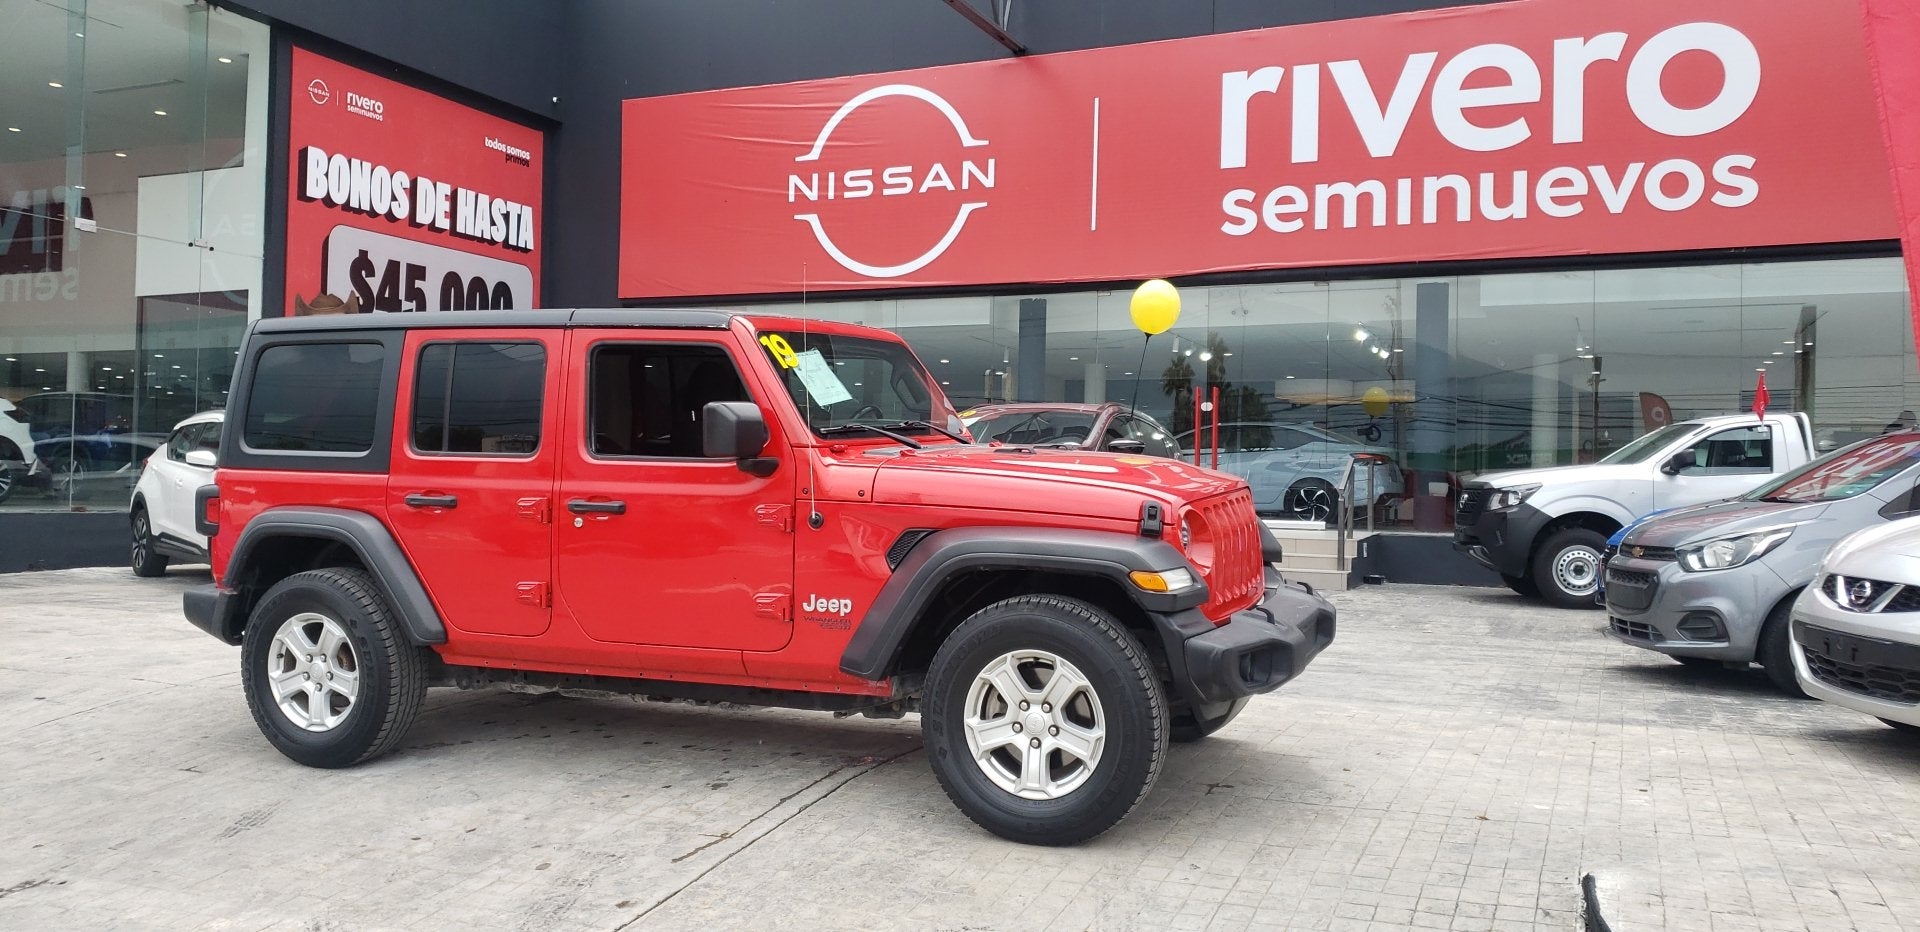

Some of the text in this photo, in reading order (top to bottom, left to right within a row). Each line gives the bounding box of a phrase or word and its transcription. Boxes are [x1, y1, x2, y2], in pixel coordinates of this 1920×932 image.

[308, 86, 330, 97] NISSAN
[347, 92, 384, 114] rivero
[1220, 21, 1762, 169] rivero
[347, 104, 384, 122] seminuevos
[484, 136, 530, 160] todos somos
[505, 153, 530, 168] primos
[788, 158, 996, 203] NISSAN
[304, 145, 534, 250] BONOS DE HASTA
[1220, 154, 1760, 236] seminuevos
[759, 334, 799, 369] 19
[802, 593, 852, 617] Jeep
